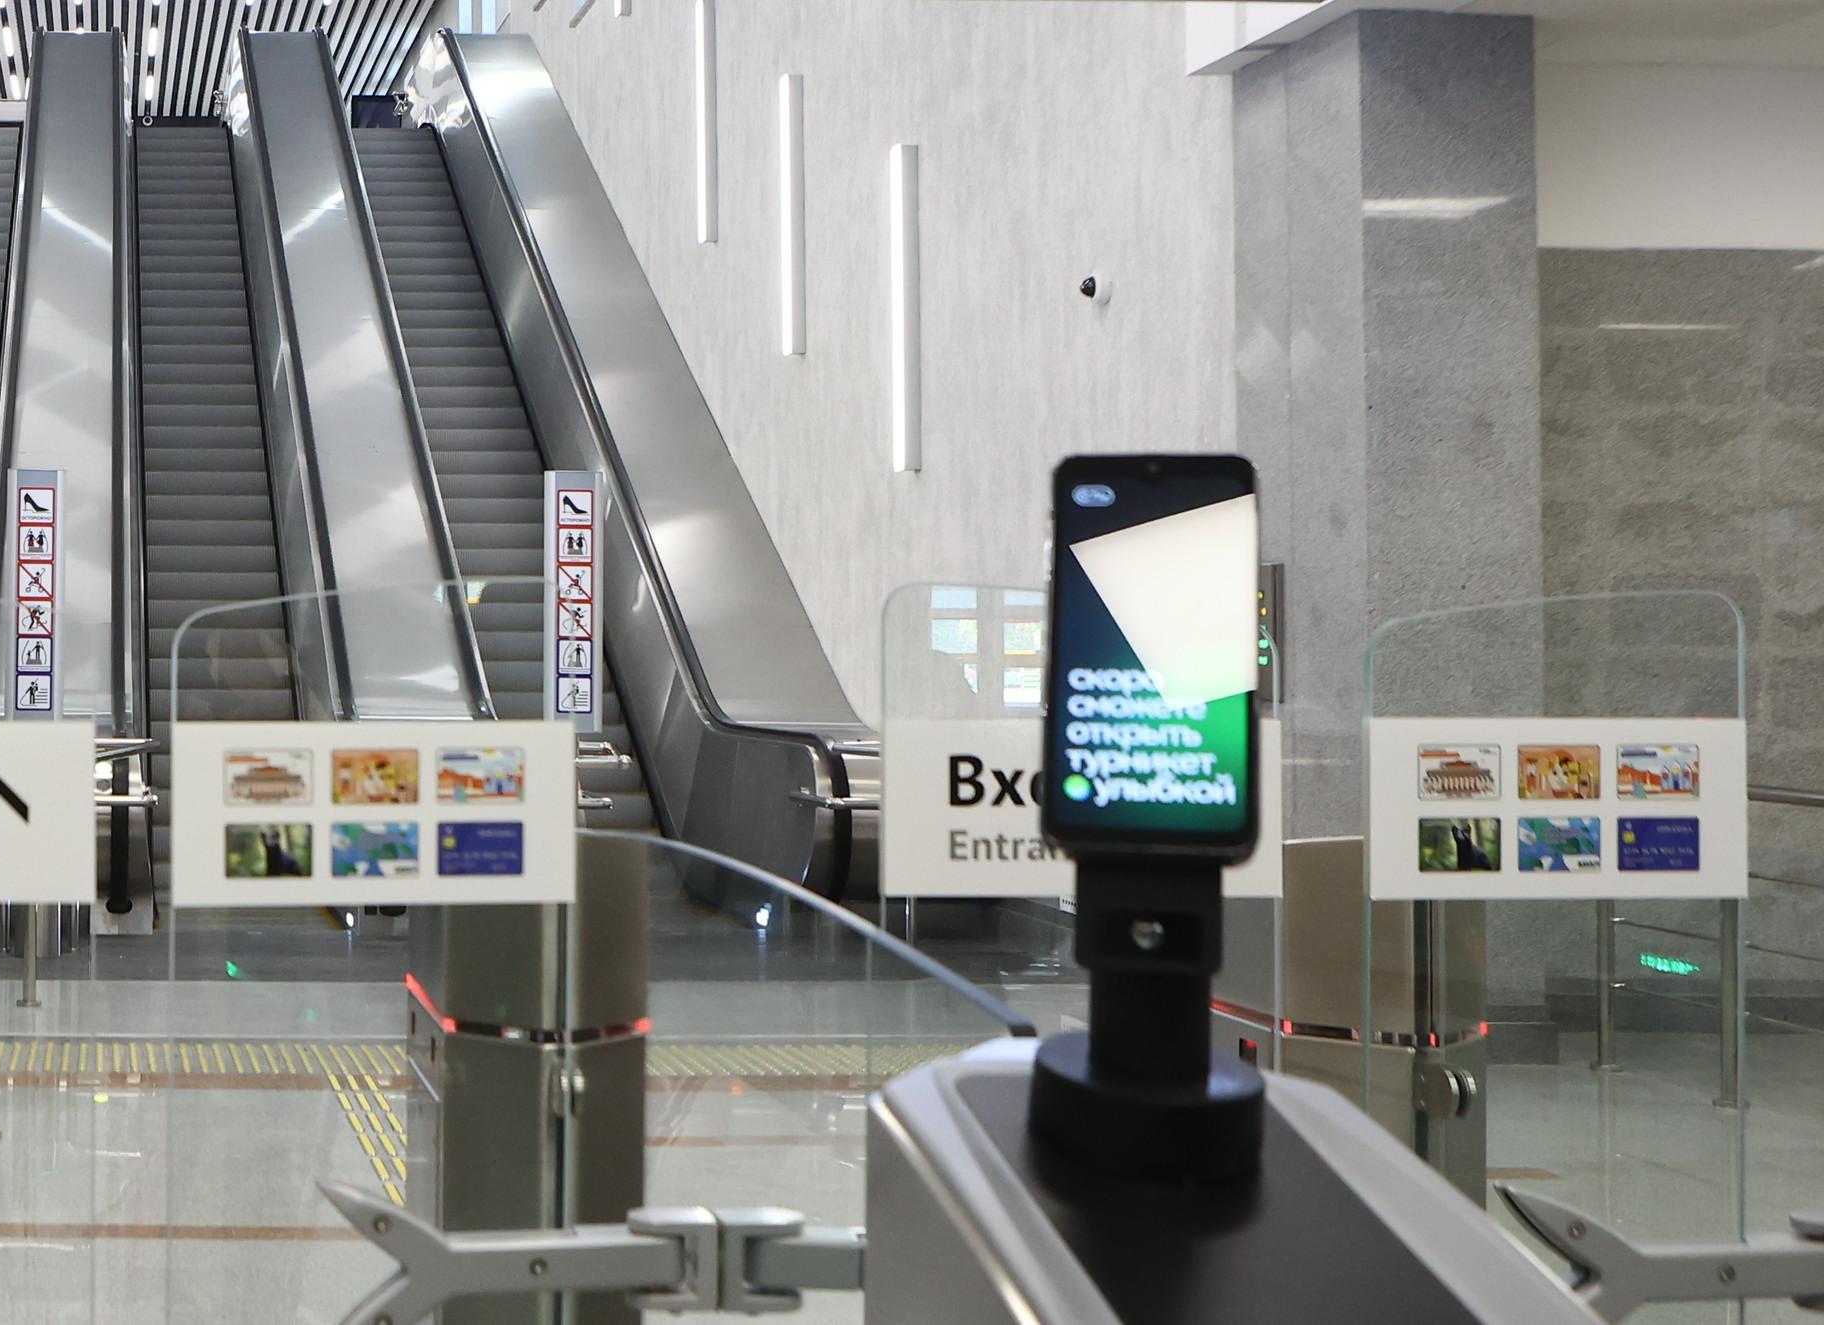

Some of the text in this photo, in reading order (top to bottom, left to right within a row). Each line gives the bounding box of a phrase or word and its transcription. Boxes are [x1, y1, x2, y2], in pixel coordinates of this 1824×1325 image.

[1068, 668, 1164, 698] скоро
[1067, 695, 1207, 720] сможете
[1066, 721, 1203, 752] открыть
[1065, 748, 1217, 777] турникет
[1093, 773, 1236, 807] улыбкой
